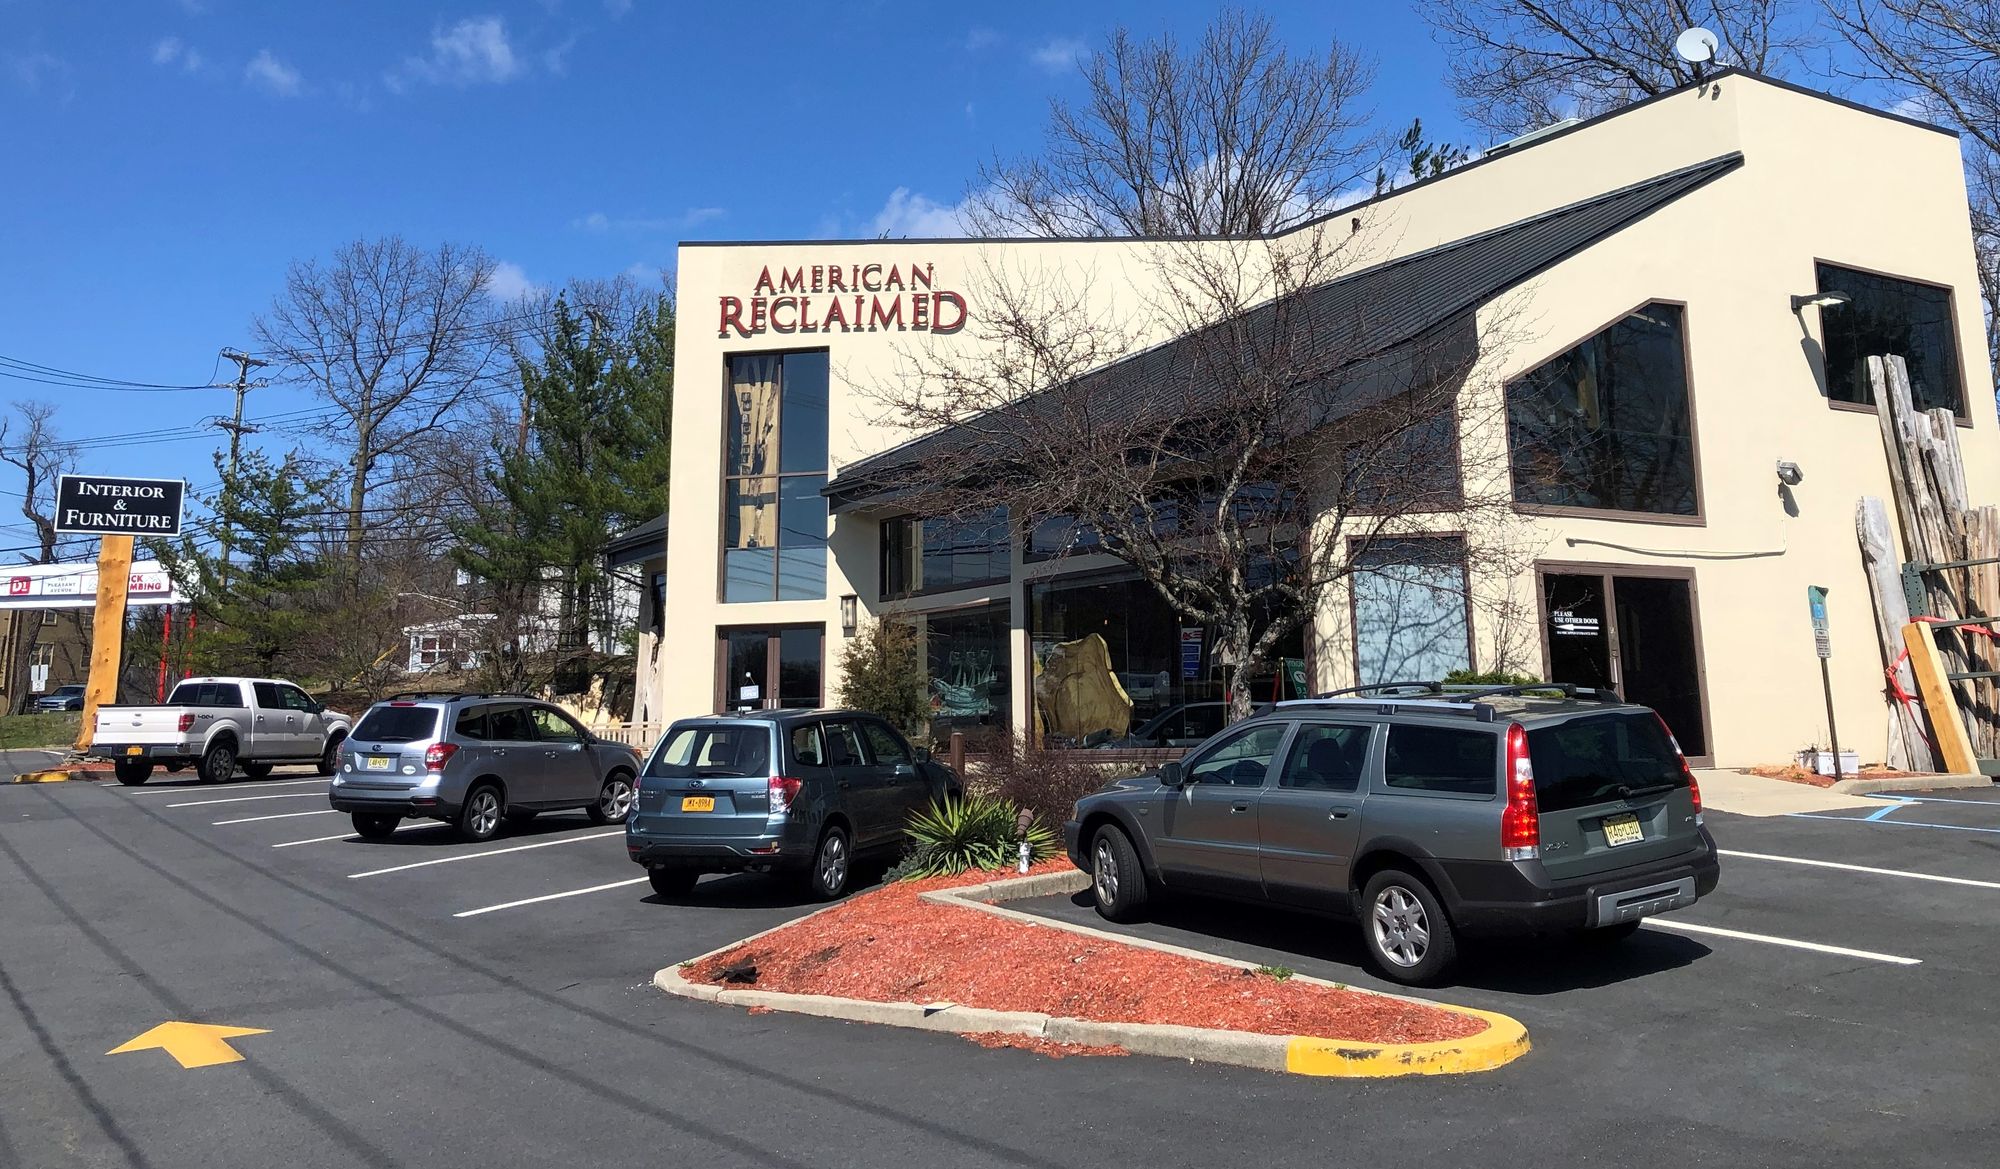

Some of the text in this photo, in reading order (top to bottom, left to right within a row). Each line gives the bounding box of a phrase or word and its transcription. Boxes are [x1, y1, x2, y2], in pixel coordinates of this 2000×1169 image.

[754, 262, 935, 295] AMERICAN
[718, 291, 968, 338] RECLAIMED
[78, 481, 165, 499] INTERIOR
[113, 499, 128, 511] &
[65, 509, 172, 529] FURNITURE
[130, 574, 144, 583] CK
[130, 582, 161, 591] MBING
